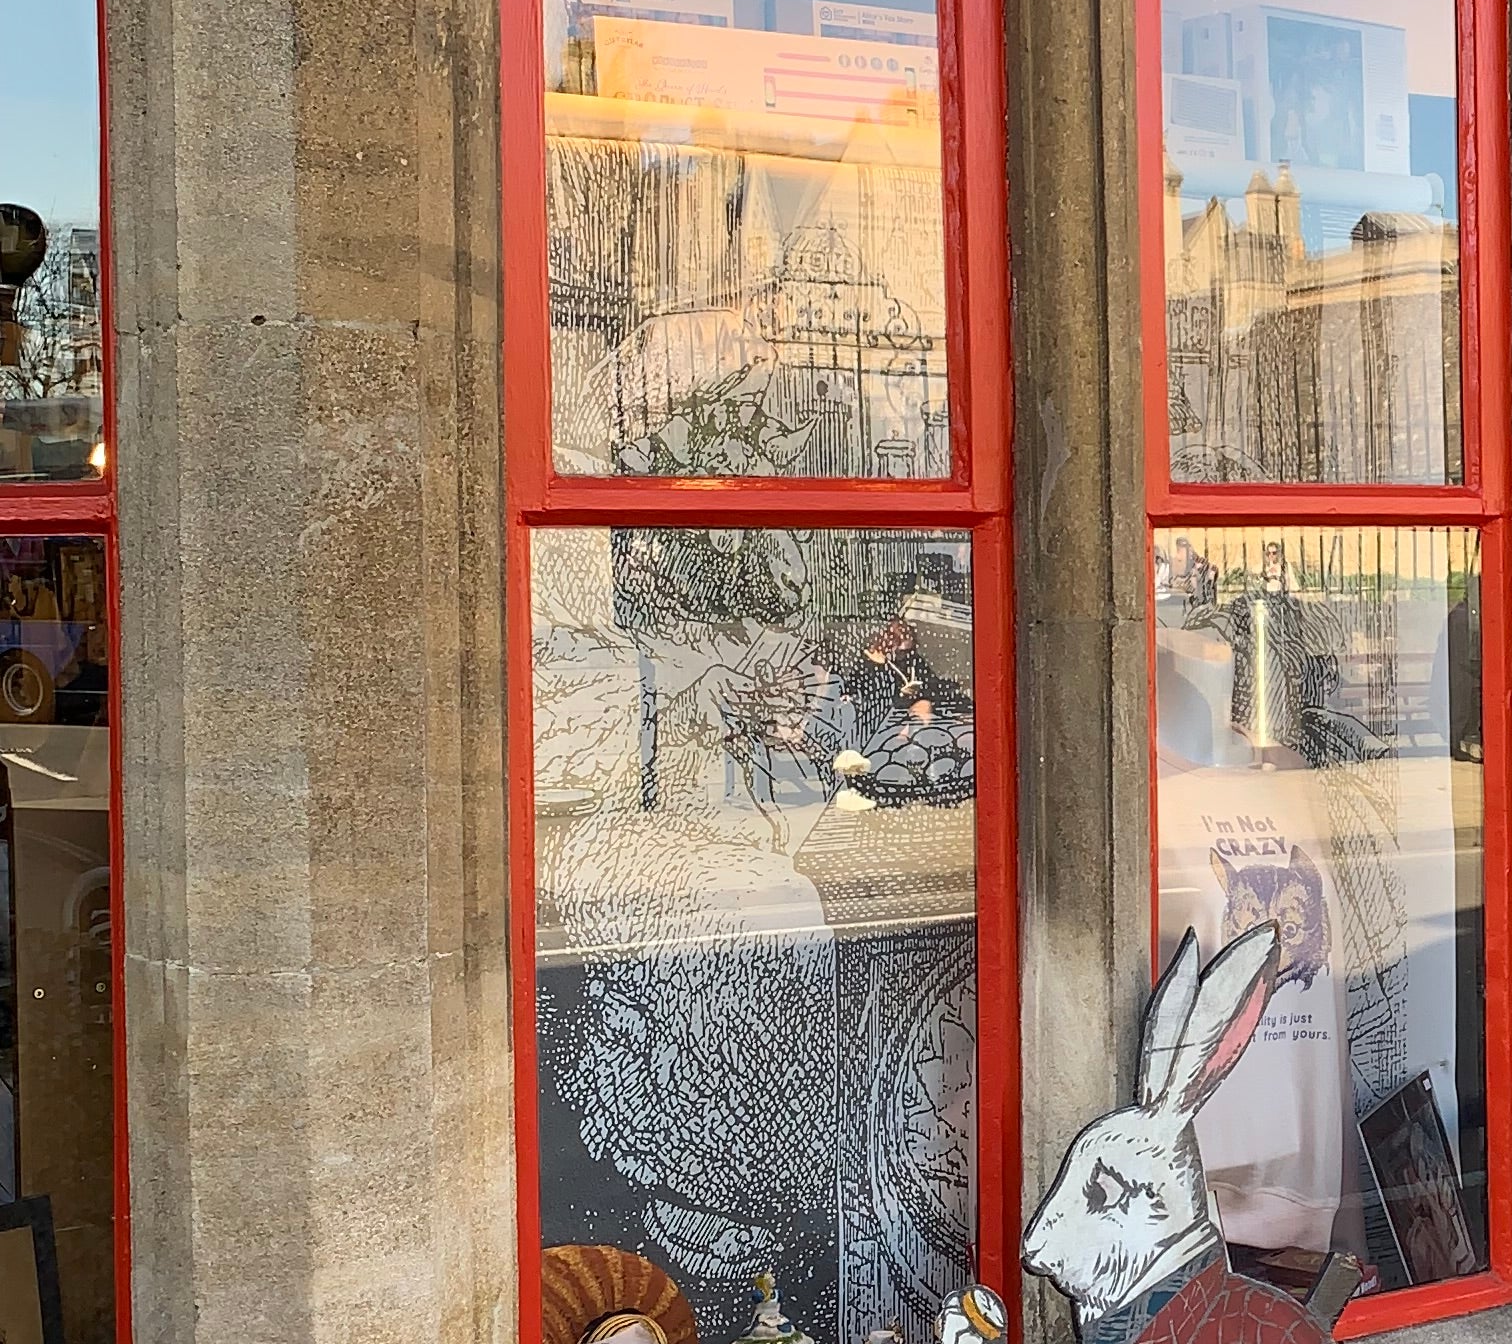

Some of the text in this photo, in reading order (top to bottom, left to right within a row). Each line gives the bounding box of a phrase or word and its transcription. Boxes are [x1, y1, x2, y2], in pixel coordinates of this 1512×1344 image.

[1201, 814, 1278, 834] I'm Not
[1215, 835, 1288, 857] CRAZY
[1280, 1014, 1287, 1025] is
[1289, 1012, 1313, 1026] just
[1264, 1030, 1286, 1042] from
[1292, 1029, 1332, 1042] yours.
